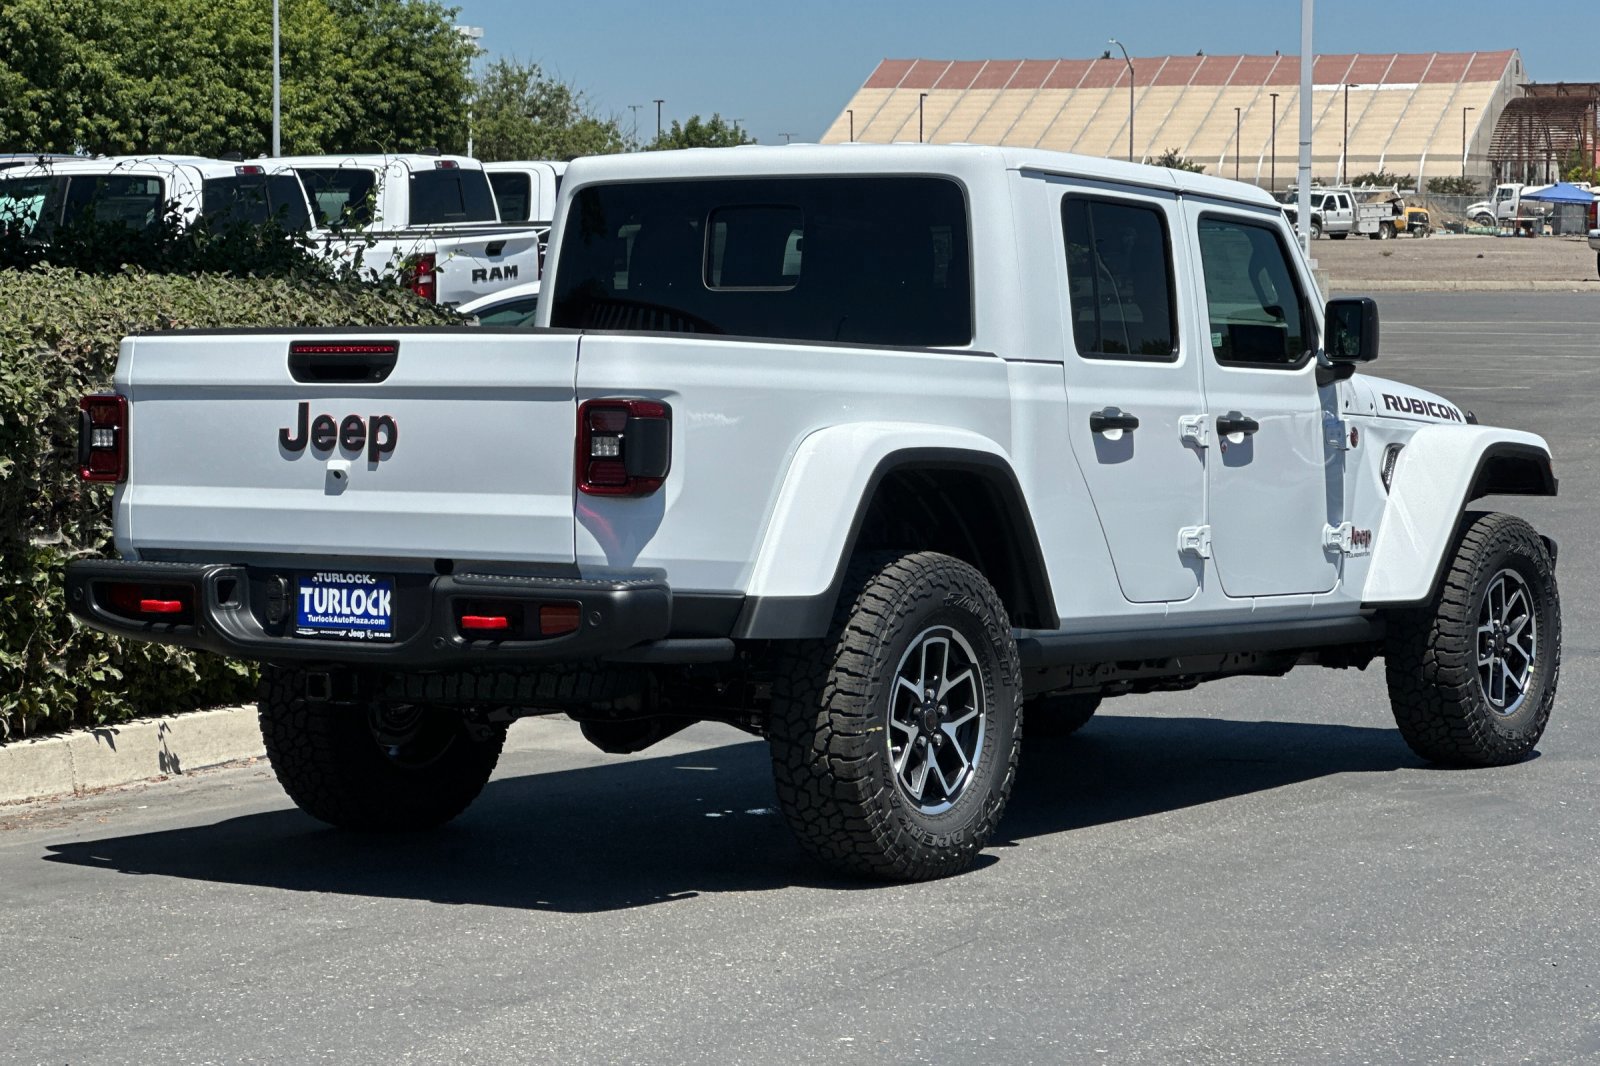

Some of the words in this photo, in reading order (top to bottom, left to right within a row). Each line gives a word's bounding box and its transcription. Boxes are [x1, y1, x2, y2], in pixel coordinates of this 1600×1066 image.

[472, 265, 518, 282] RAM
[1382, 393, 1462, 423] RUBICON
[279, 402, 397, 462] Jeep
[1351, 526, 1372, 548] Jeep
[316, 573, 371, 584] TURLOCK
[300, 587, 391, 616] TURLOCK
[307, 615, 385, 625] TurlockAutoPlaza.com
[348, 629, 366, 639] Jeep
